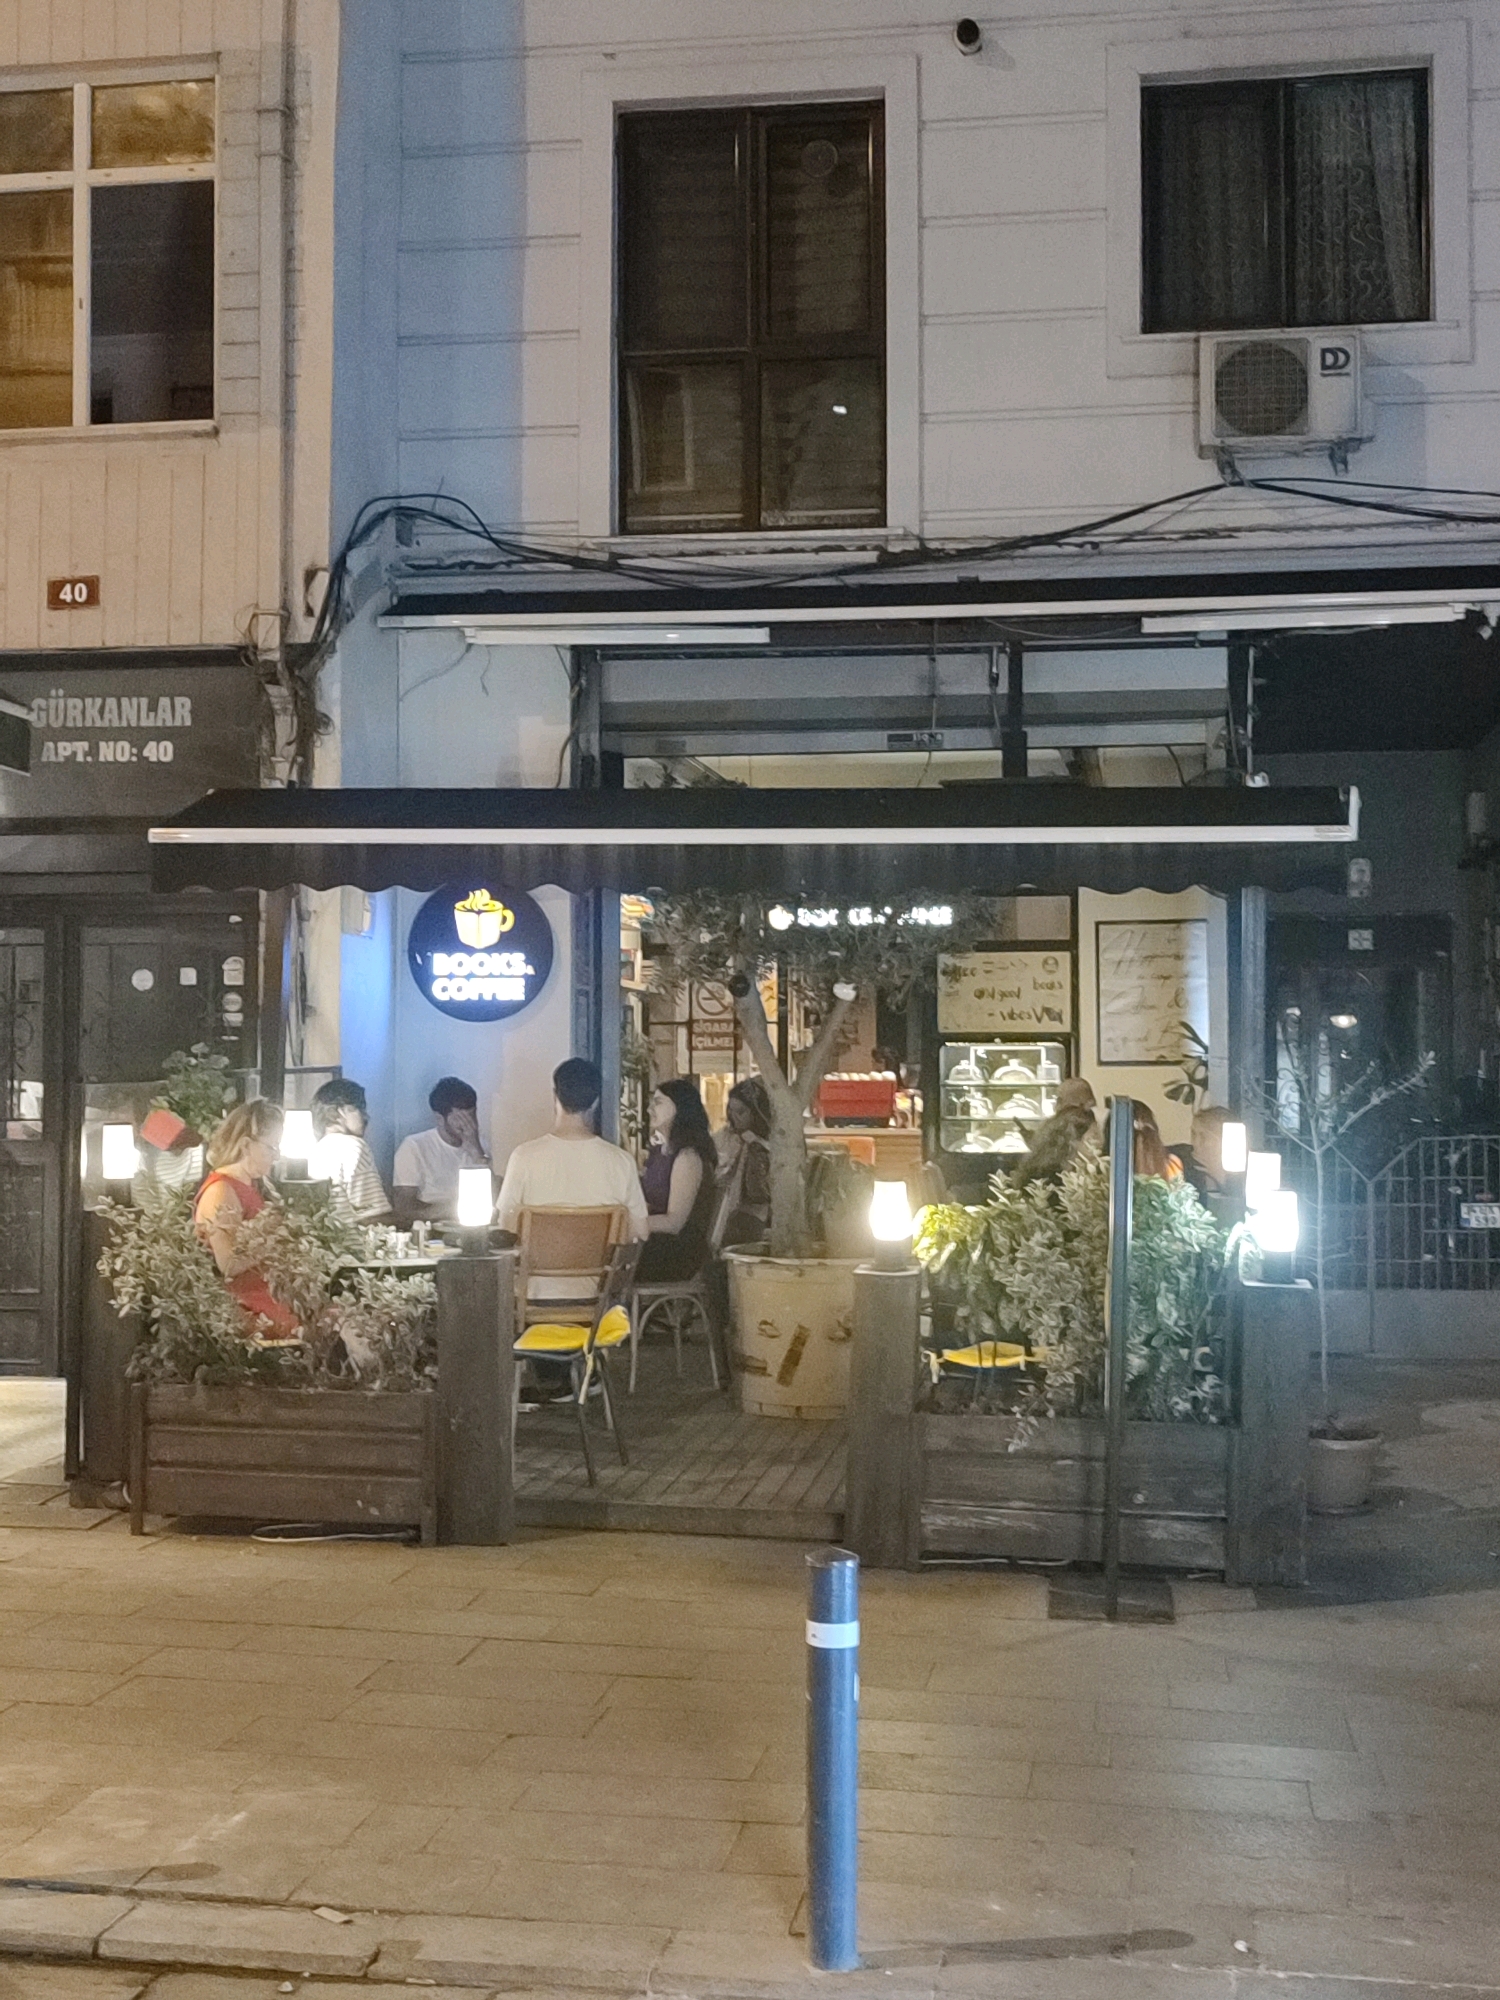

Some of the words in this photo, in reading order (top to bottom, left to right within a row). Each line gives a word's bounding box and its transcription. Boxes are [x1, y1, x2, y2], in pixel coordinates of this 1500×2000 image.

[58, 582, 88, 603] 40
[31, 687, 192, 728] GÜRKANLAR
[41, 741, 93, 763] APT.
[98, 740, 138, 763] NO:
[142, 740, 174, 763] 40
[431, 977, 526, 1001] COFFEE
